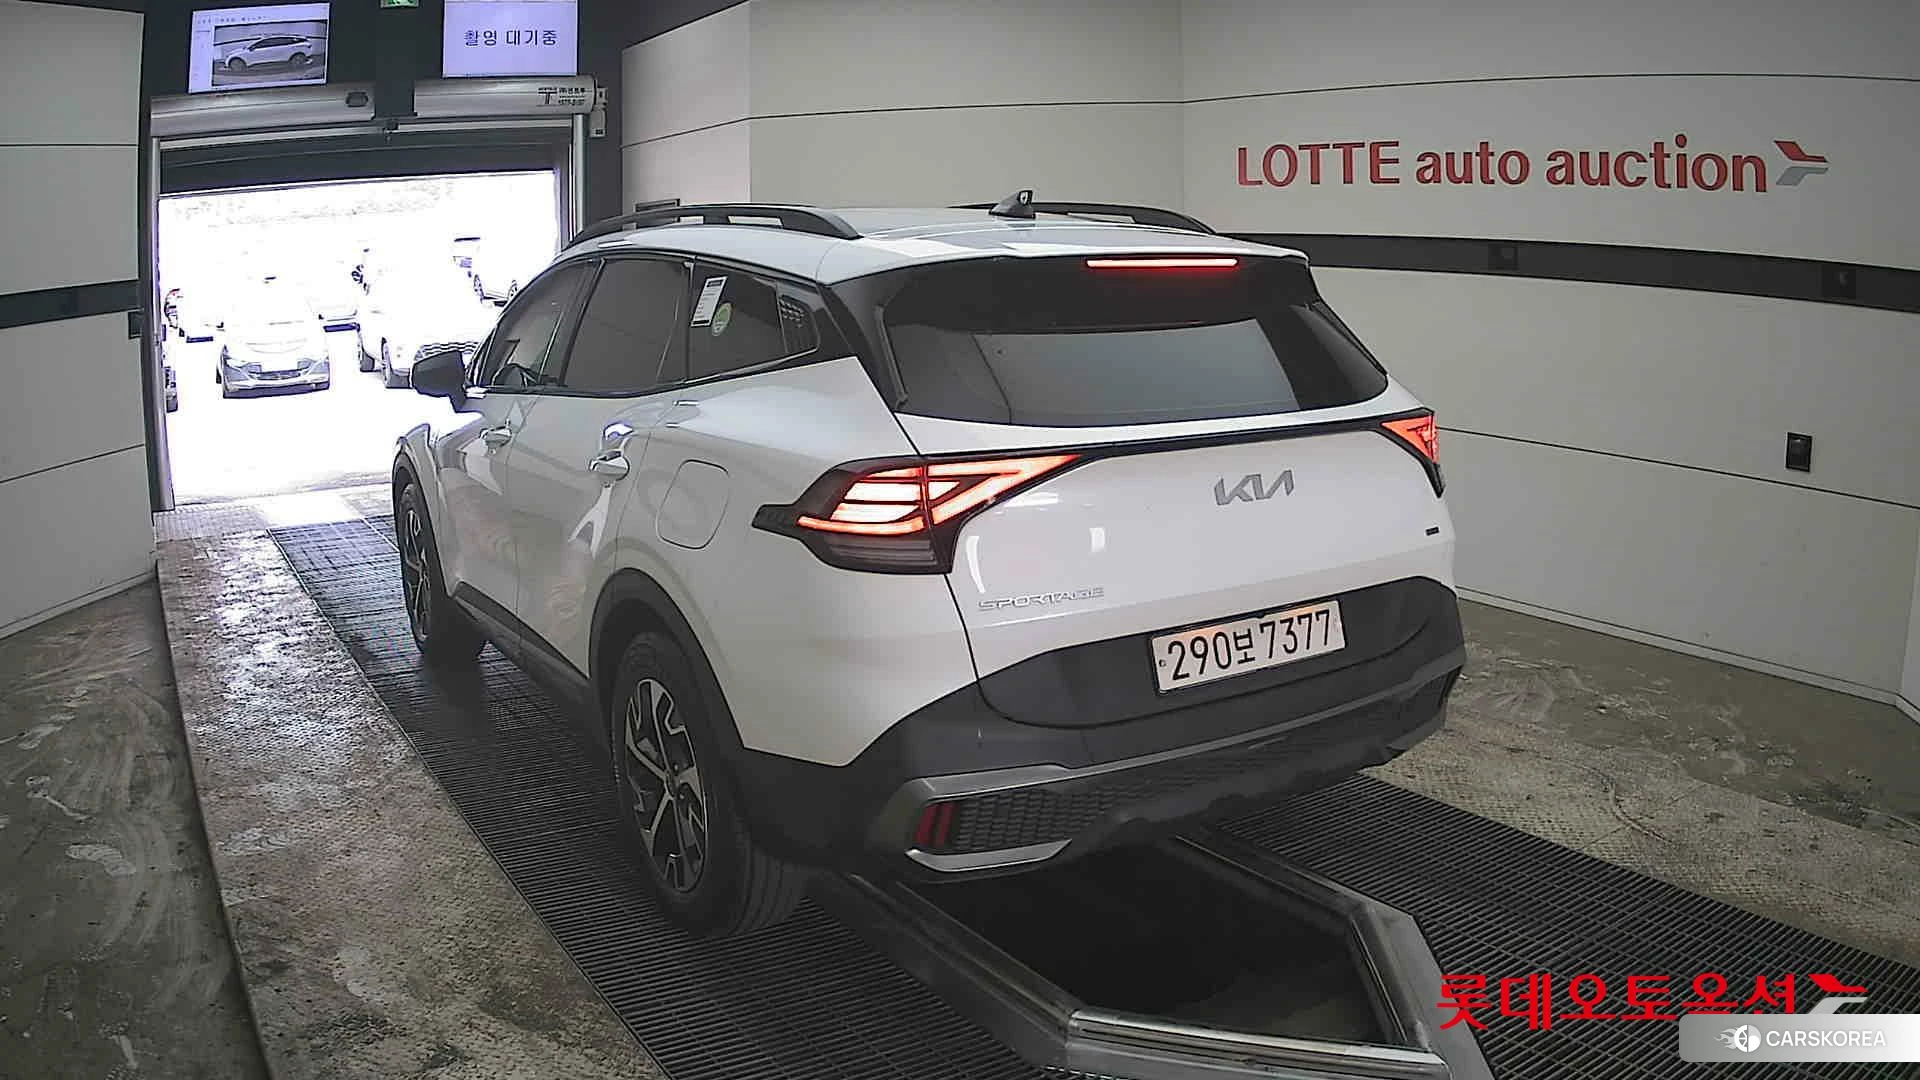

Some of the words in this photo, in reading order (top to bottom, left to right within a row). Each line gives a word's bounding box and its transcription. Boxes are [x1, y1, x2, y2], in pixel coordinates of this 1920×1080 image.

[464, 29, 498, 47] 촬영
[506, 29, 558, 46] 대기중
[1237, 140, 1400, 187] LOTTE
[1416, 141, 1531, 186] auto
[1545, 134, 1767, 193] auction
[1214, 469, 1294, 505] KIA
[978, 587, 1105, 611] SPORTAGE
[1167, 609, 1331, 681] 290보7377
